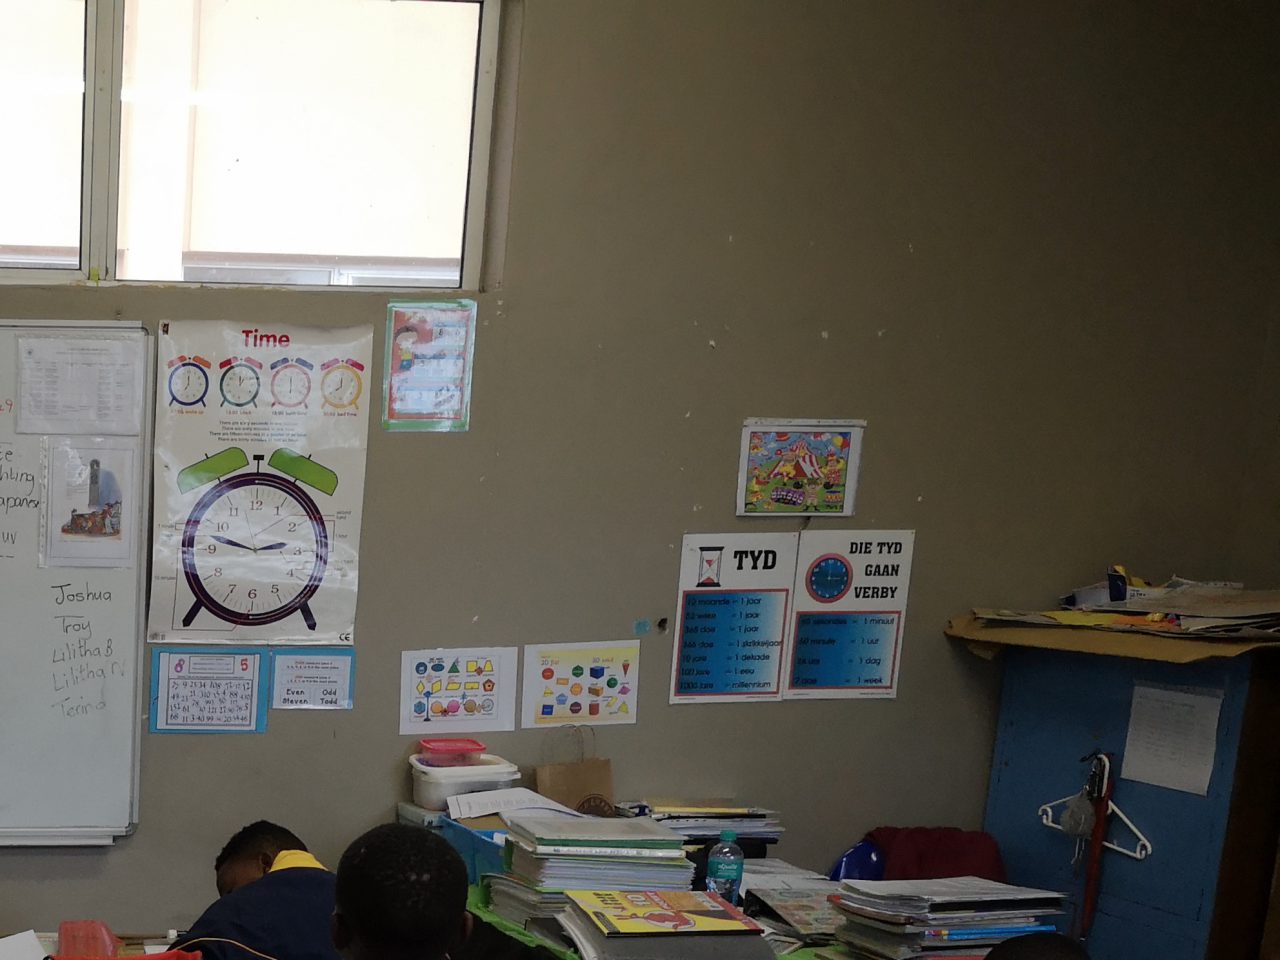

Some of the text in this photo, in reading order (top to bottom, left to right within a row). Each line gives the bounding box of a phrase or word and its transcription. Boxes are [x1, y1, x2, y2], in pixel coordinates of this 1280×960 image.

[242, 329, 290, 348] Time
[250, 500, 263, 511] 12
[273, 505, 281, 515] 1
[229, 507, 239, 517] 11
[216, 522, 229, 532] 10
[288, 522, 297, 532] 2
[208, 544, 217, 555] 9
[293, 547, 302, 555] 3
[849, 541, 903, 555] DIE TYD
[733, 549, 778, 571] TYD
[214, 567, 222, 577] 8
[286, 568, 294, 578] 4
[864, 564, 900, 577] GAAN
[51, 582, 112, 605] Joshua
[228, 584, 237, 594] 7
[247, 588, 257, 599] 6
[270, 584, 279, 594] 5
[853, 586, 898, 599] VERBY
[54, 615, 92, 640] Troy
[175, 658, 185, 673] 8
[240, 658, 248, 671] 5
[866, 657, 881, 665] dag
[286, 688, 305, 696] Even
[322, 688, 337, 696] Odd
[282, 697, 309, 705] Steven
